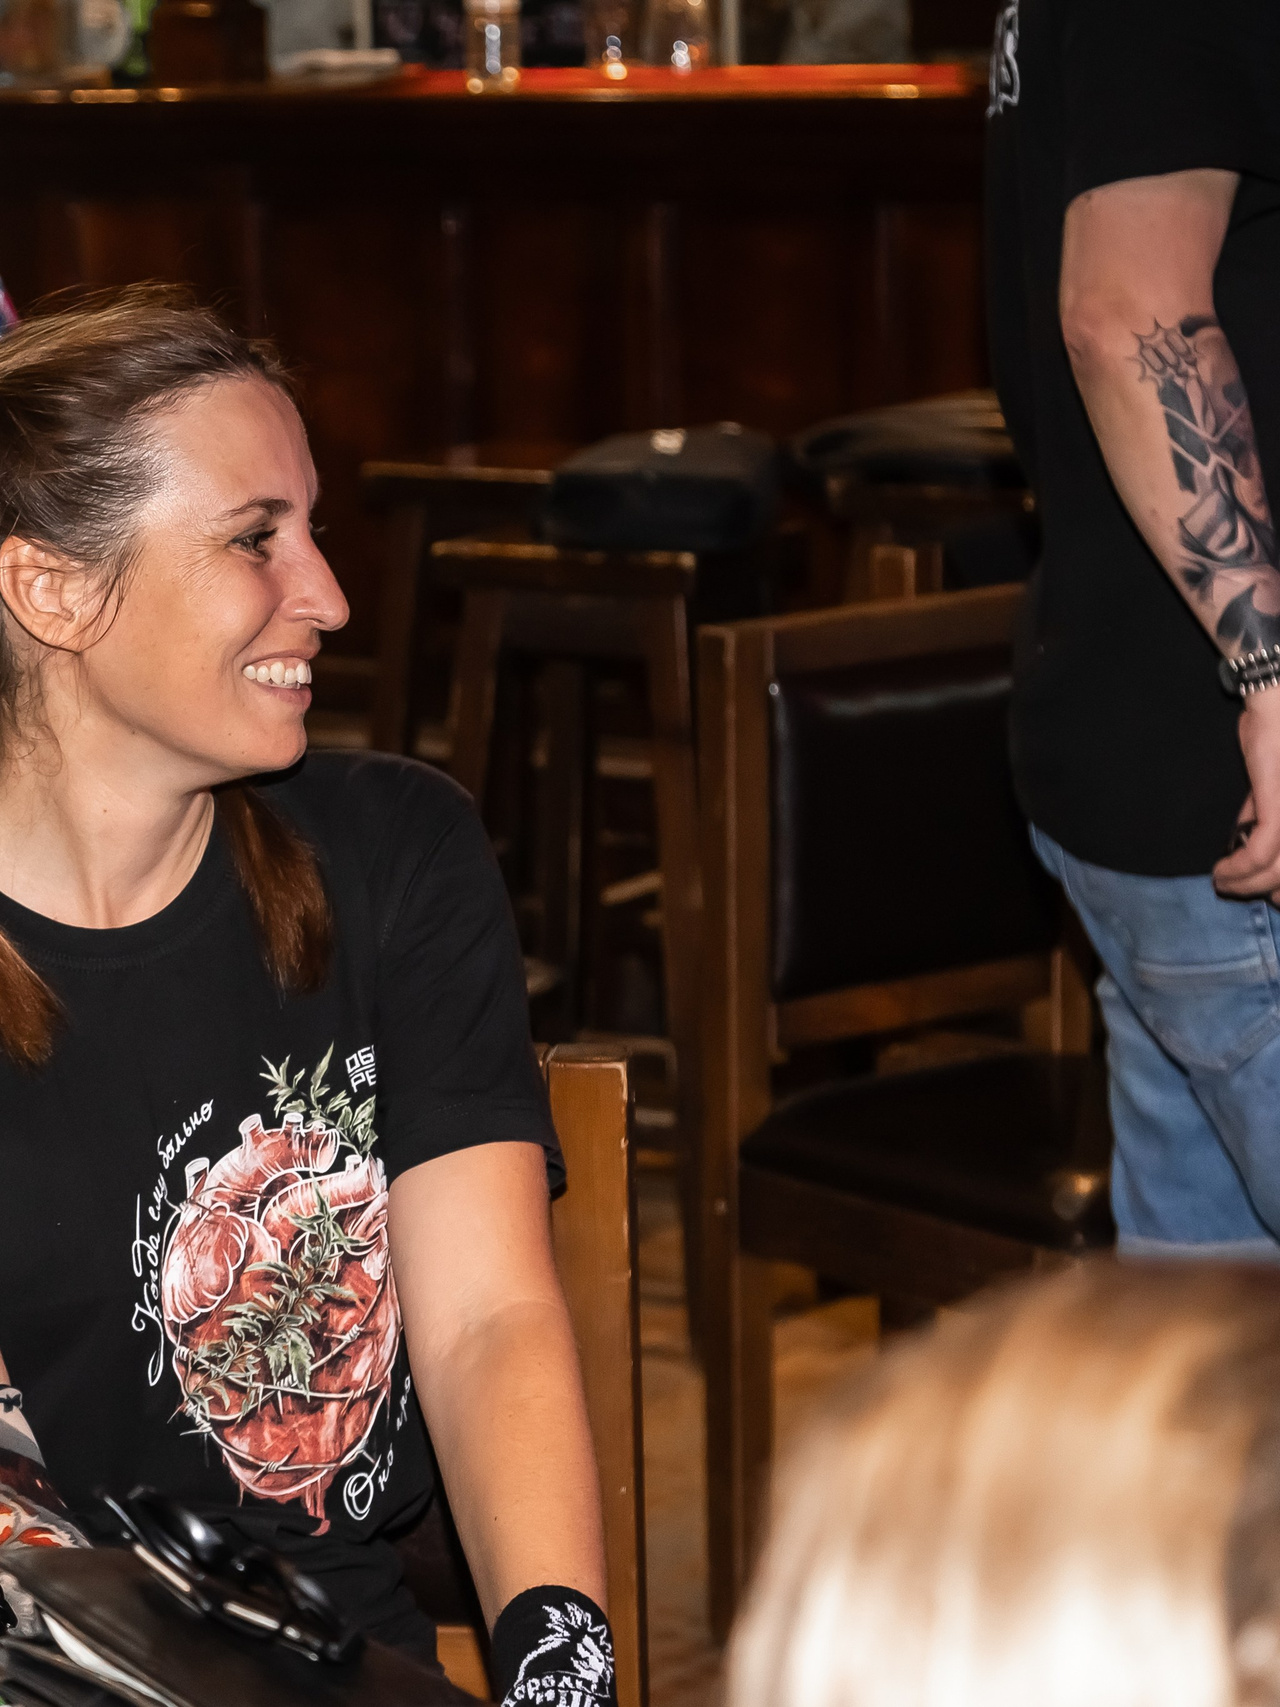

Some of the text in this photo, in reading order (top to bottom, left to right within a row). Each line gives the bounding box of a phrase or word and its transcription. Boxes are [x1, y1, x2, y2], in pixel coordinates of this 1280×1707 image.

[345, 1044, 375, 1074] ОБ
[132, 1099, 214, 1386] Когда ему больно
